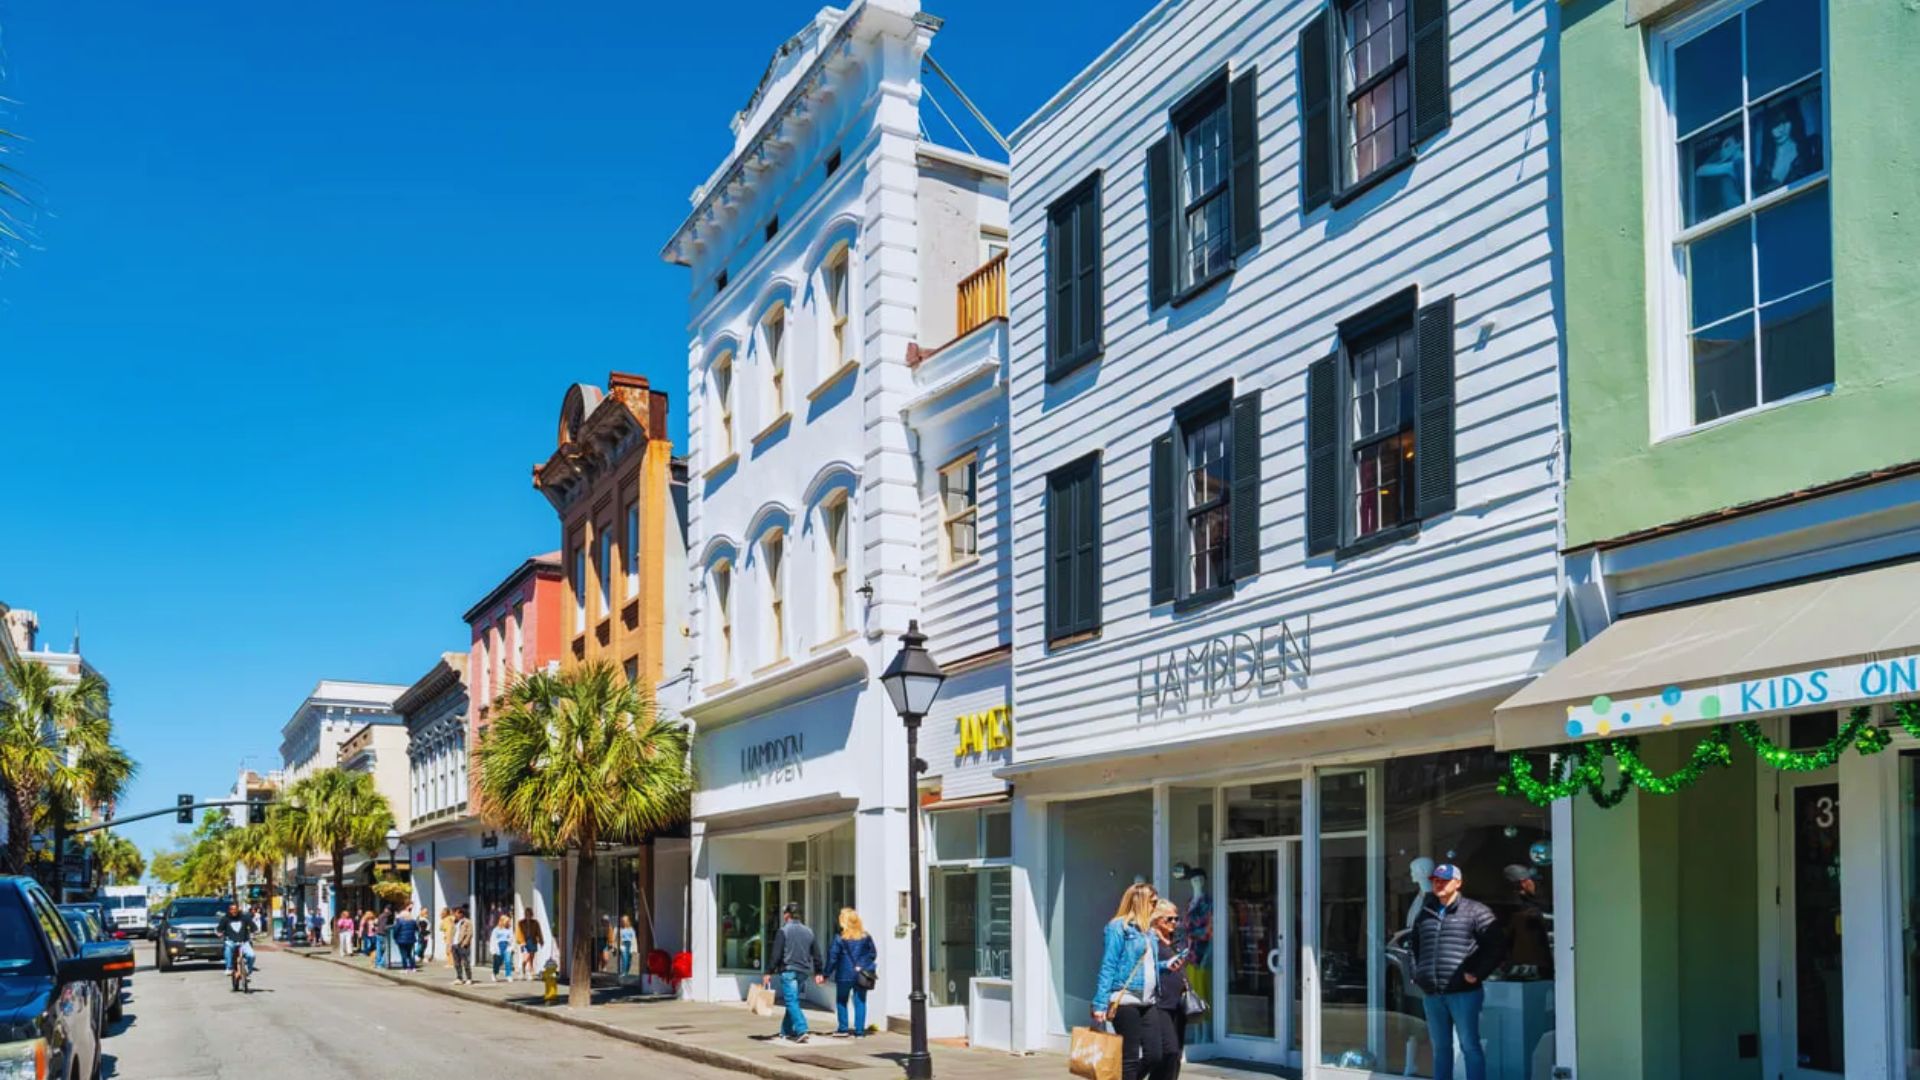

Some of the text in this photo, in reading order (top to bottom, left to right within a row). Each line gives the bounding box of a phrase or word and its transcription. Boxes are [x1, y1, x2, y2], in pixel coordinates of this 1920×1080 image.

[1137, 613, 1311, 718] HAMPDEN
[1741, 657, 1917, 713] KIDS ON
[1816, 797, 1840, 828] 3
